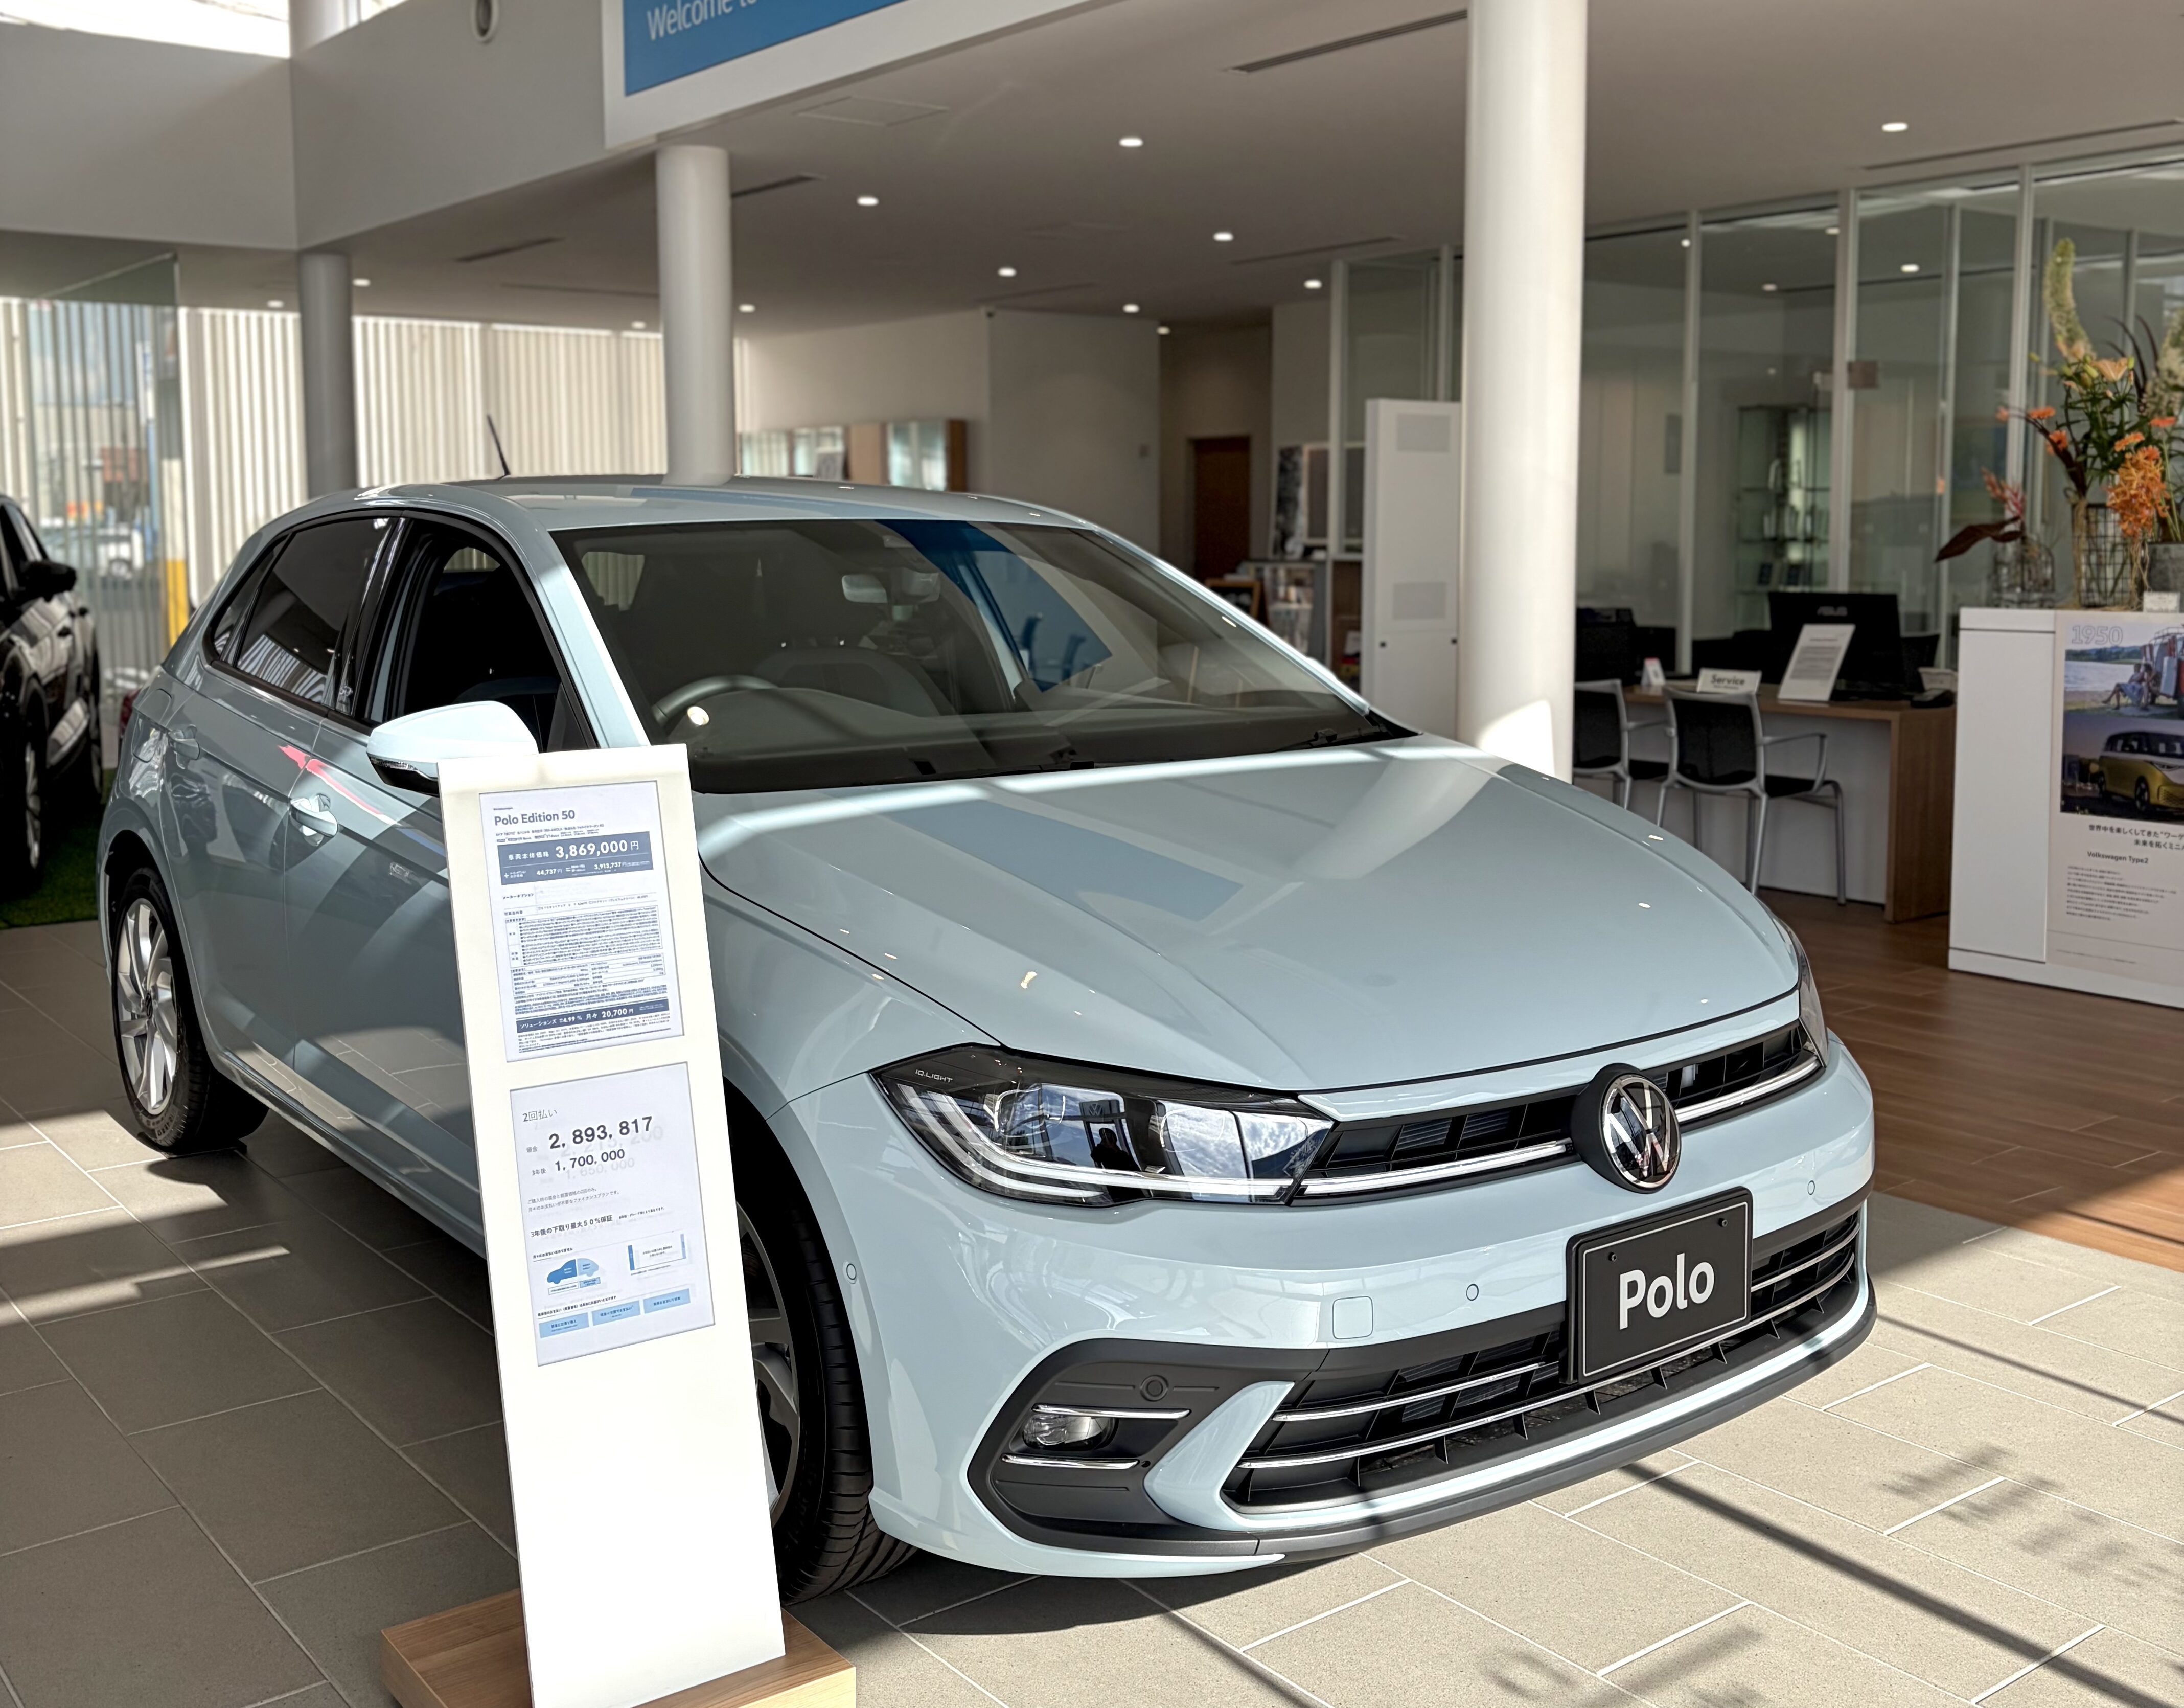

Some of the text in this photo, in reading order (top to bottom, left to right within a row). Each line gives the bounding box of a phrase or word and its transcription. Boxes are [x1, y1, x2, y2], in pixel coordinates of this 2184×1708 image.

[2071, 625, 2123, 646] 1950
[1711, 674, 1745, 686] Service
[494, 810, 576, 826] Polo Edition 50
[2087, 851, 2127, 861] Volkswagen
[915, 1069, 953, 1083] IQ.LIGHT
[522, 1108, 558, 1122] 2回払い
[1619, 1252, 1715, 1330] Polo
